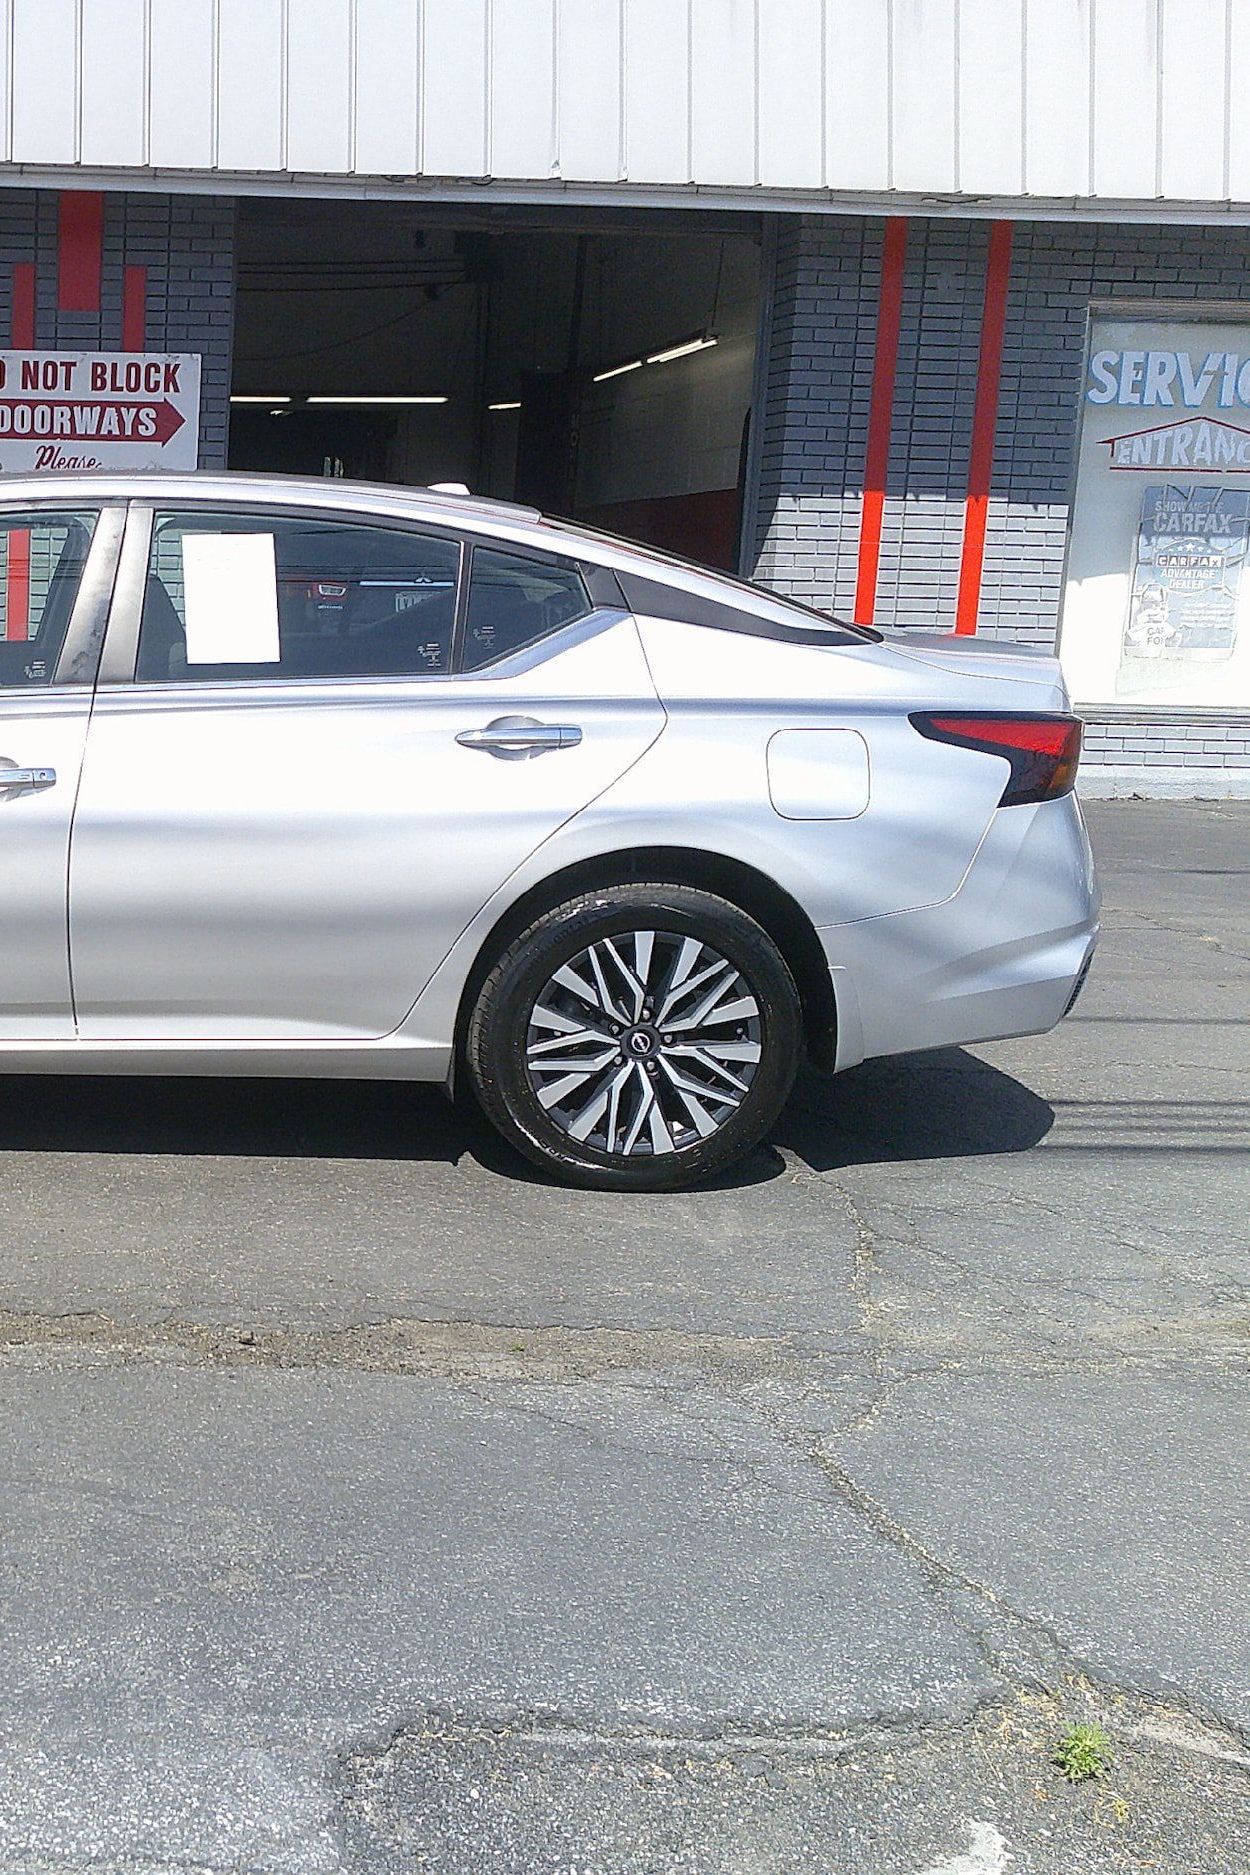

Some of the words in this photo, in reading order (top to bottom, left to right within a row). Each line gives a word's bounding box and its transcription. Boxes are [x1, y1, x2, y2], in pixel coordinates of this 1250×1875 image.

[21, 360, 78, 392] NOT
[90, 362, 181, 393] BLOCK
[35, 444, 103, 470] Please
[1204, 502, 1224, 513] TE
[1153, 512, 1233, 534] CARFAX
[1158, 555, 1221, 567] CARFAX
[1160, 568, 1217, 579] ADVANTAGE
[1169, 579, 1205, 589] DEALER
